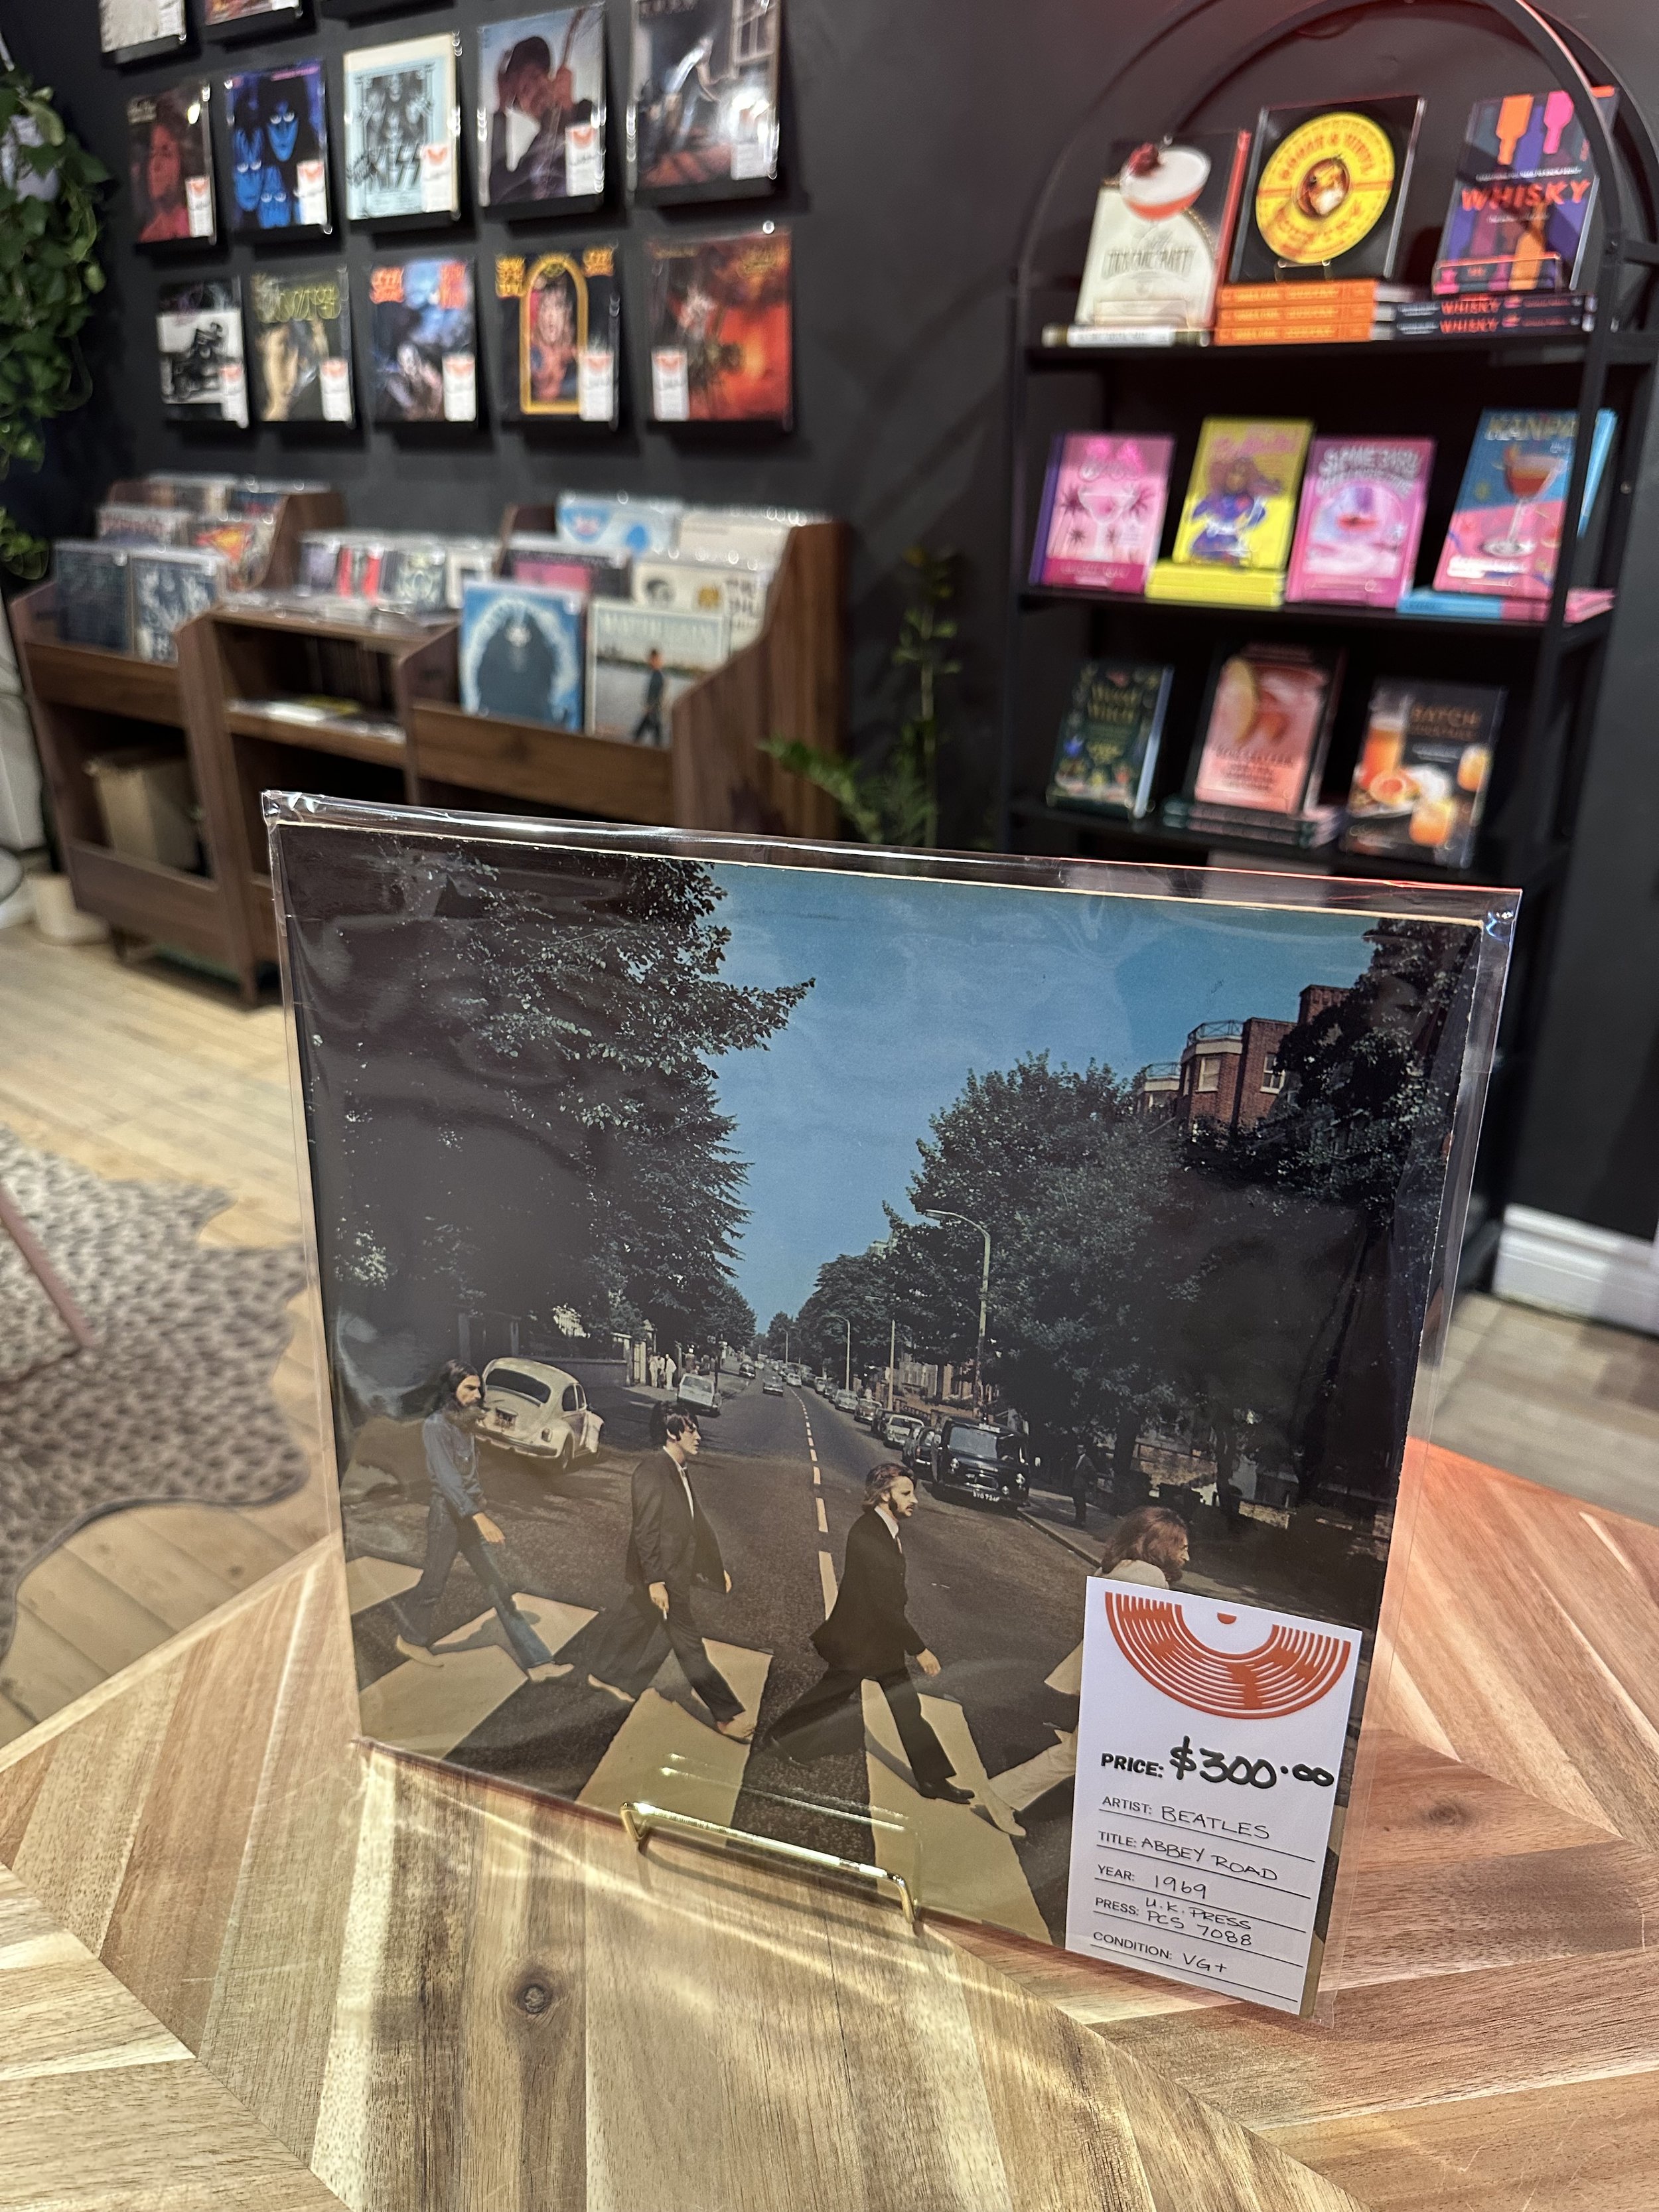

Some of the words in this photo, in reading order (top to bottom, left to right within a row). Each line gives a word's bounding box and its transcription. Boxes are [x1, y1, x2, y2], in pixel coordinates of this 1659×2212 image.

[1461, 179, 1591, 212] WHISKY
[1439, 317, 1499, 332] WHISKY
[1485, 412, 1579, 439] KANPA
[1100, 1753, 1164, 1778] PRICE:
[1169, 1735, 1335, 1789] $300.00
[1102, 1795, 1152, 1814] ARTIST:
[1161, 1805, 1270, 1840] BEATLES
[1098, 1830, 1137, 1848] TITLE:
[1141, 1837, 1205, 1862] ABBEY
[1210, 1854, 1278, 1881] ROAD
[1097, 1864, 1135, 1881] YEAR:
[1155, 1874, 1207, 1899] 1969
[1095, 1897, 1139, 1917] PRESS:
[1189, 1906, 1252, 1930] PRESS
[1147, 1909, 1185, 1929] PCS
[1196, 1923, 1253, 1946] 7088
[1093, 1931, 1173, 1960] CONDITION:
[1183, 1952, 1228, 1973] VG+
